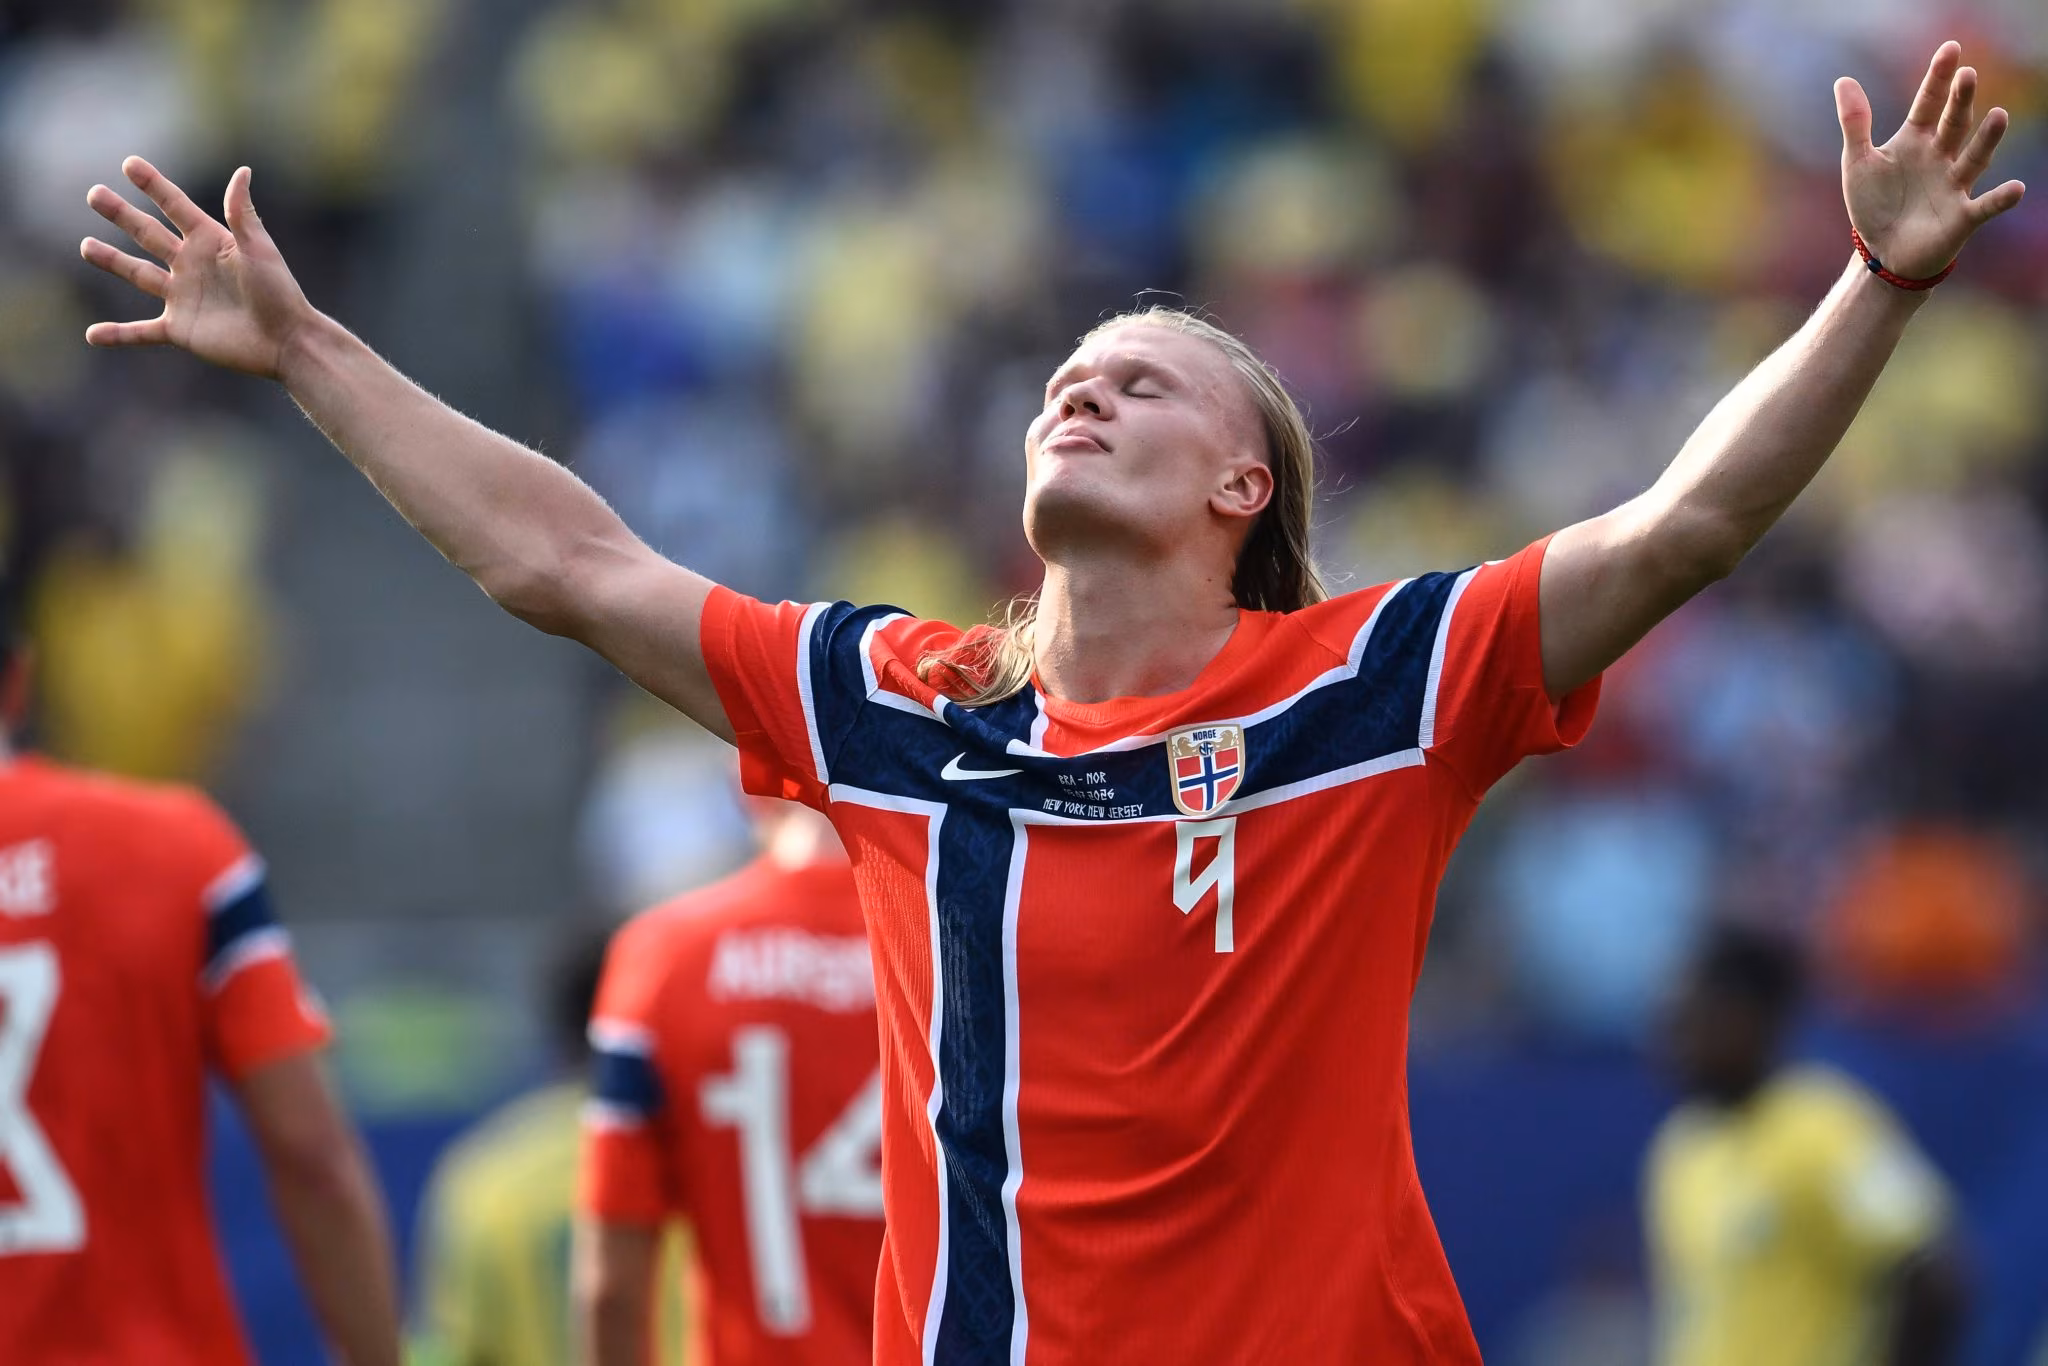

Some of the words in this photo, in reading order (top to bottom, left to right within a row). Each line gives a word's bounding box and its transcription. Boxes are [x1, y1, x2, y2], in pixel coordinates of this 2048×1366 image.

[1192, 729, 1217, 741] NORGE
[1058, 774, 1076, 786] BRA
[1086, 772, 1106, 785] NOR
[1042, 798, 1062, 811] NEW
[1063, 801, 1086, 816] YORK
[1087, 805, 1105, 818] NEW
[1107, 803, 1144, 819] JERSEY
[1173, 817, 1237, 952] 9
